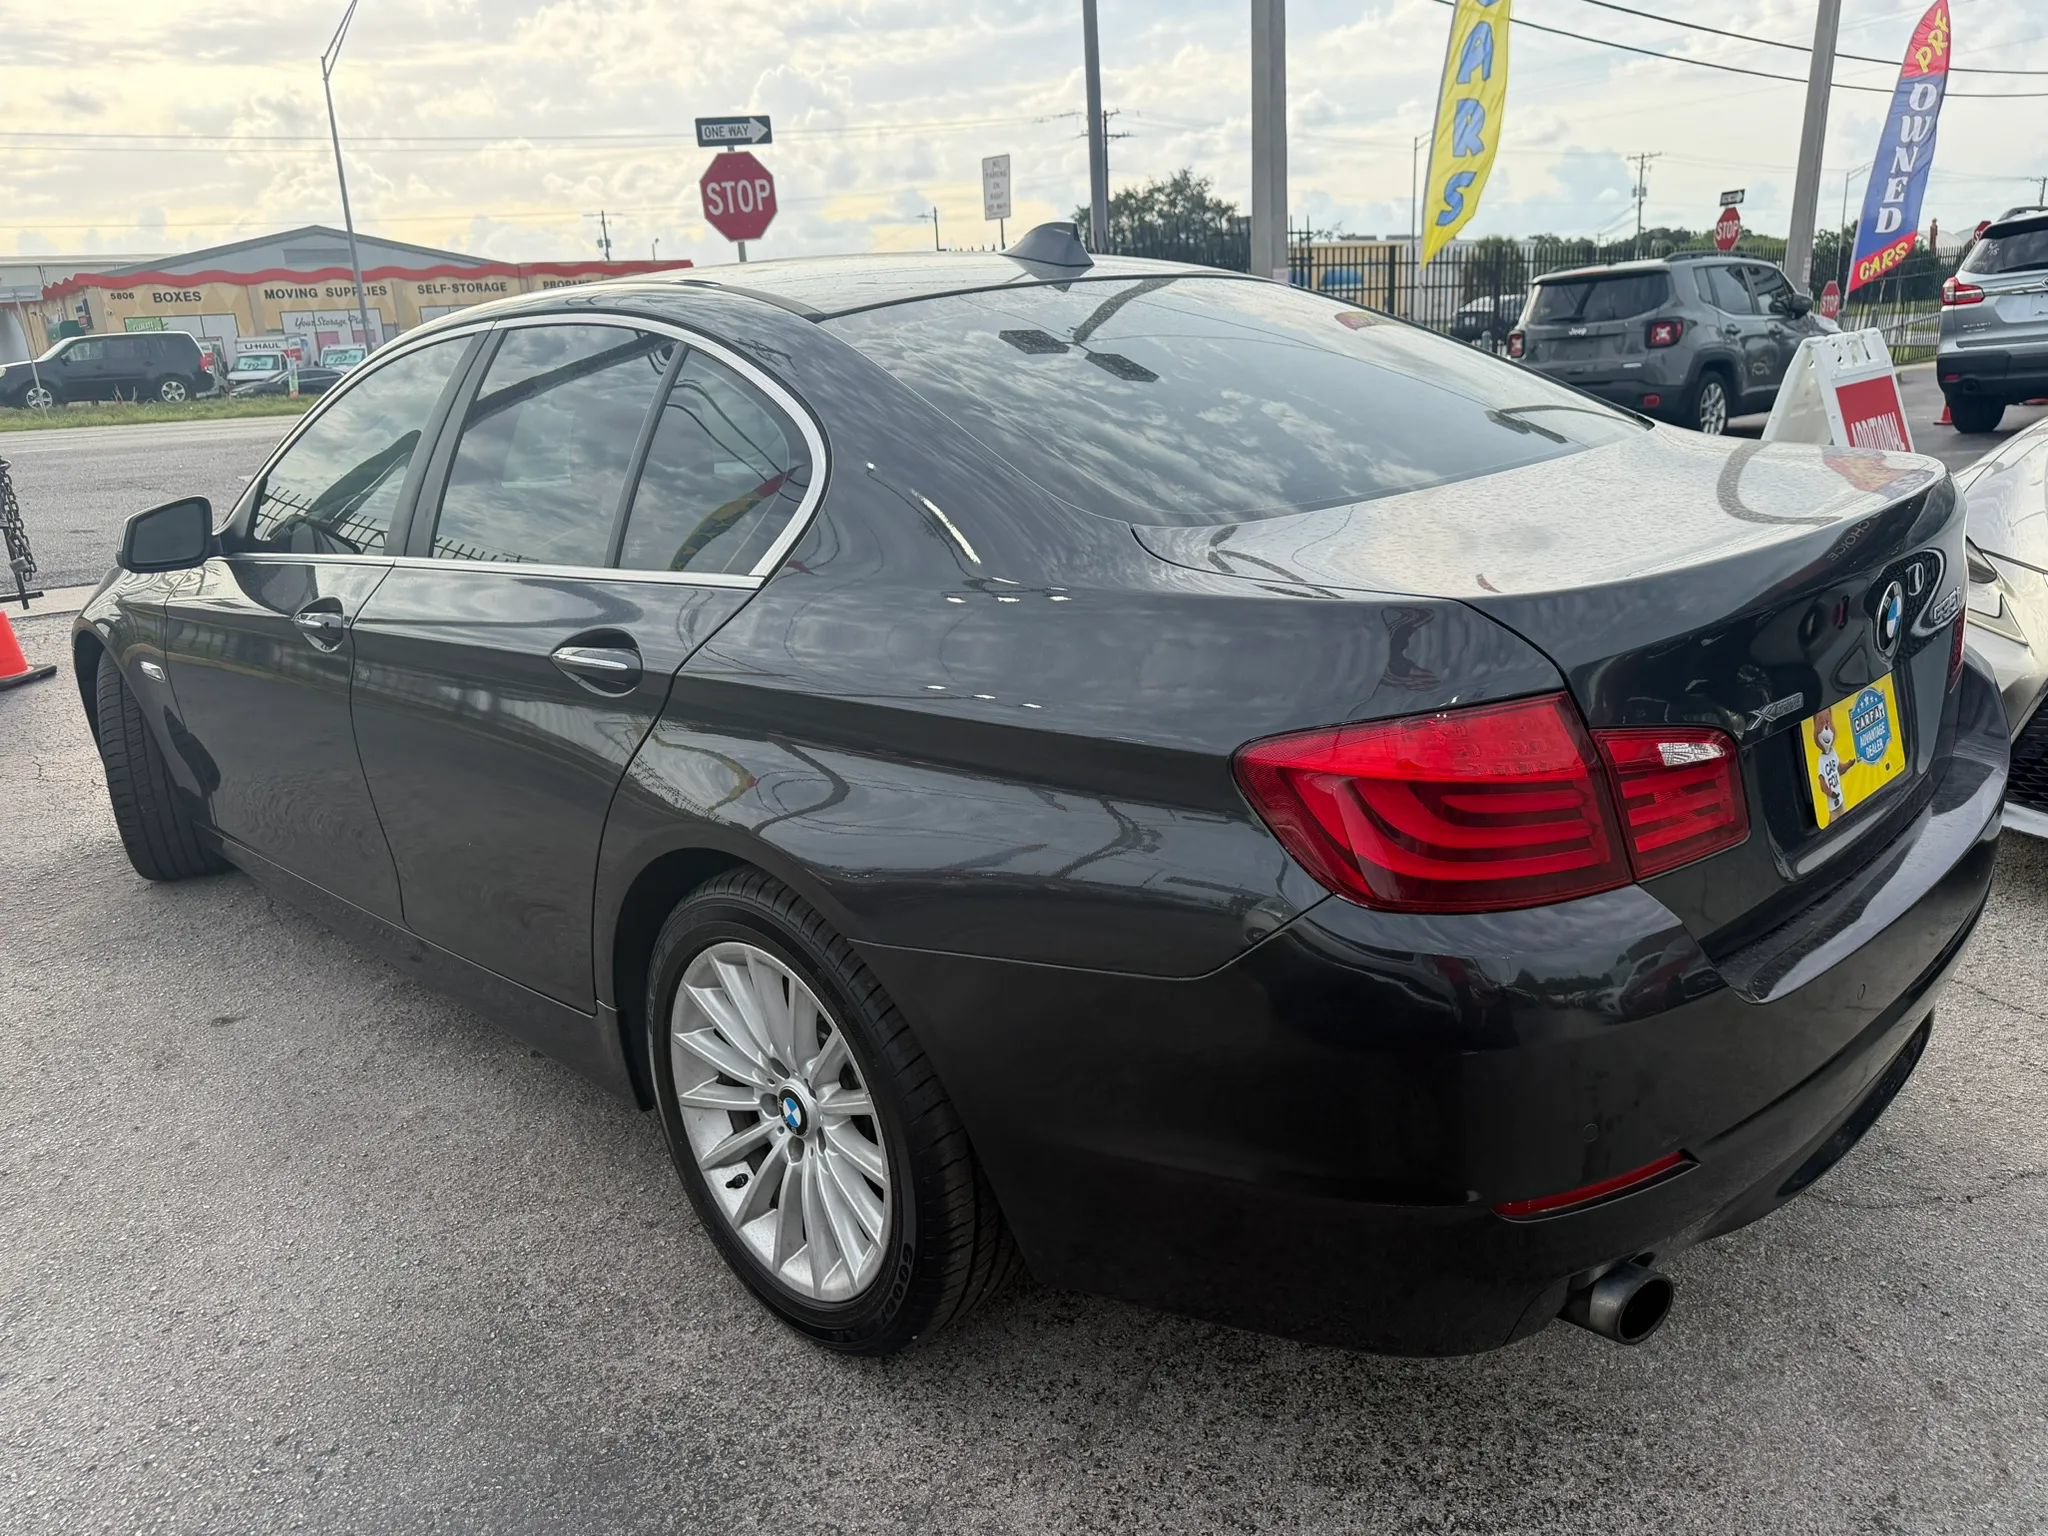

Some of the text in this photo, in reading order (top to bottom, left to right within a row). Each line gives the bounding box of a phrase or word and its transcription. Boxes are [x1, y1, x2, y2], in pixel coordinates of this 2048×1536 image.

[1436, 0, 1499, 226] ARS
[704, 125, 749, 138] ONE WAY
[1874, 83, 1937, 234] OWNED
[706, 178, 771, 216] STOP
[1716, 220, 1739, 240] STOP
[1859, 241, 1909, 281] CARS
[110, 292, 135, 300] 5806
[153, 291, 202, 303] BOXES
[264, 285, 387, 299] MOVING SUPPIES
[417, 282, 508, 295] SELF-STORAGE
[1822, 295, 1839, 313] STOP
[1568, 327, 1587, 336] Jeep
[1855, 702, 1885, 732] CARFAX
